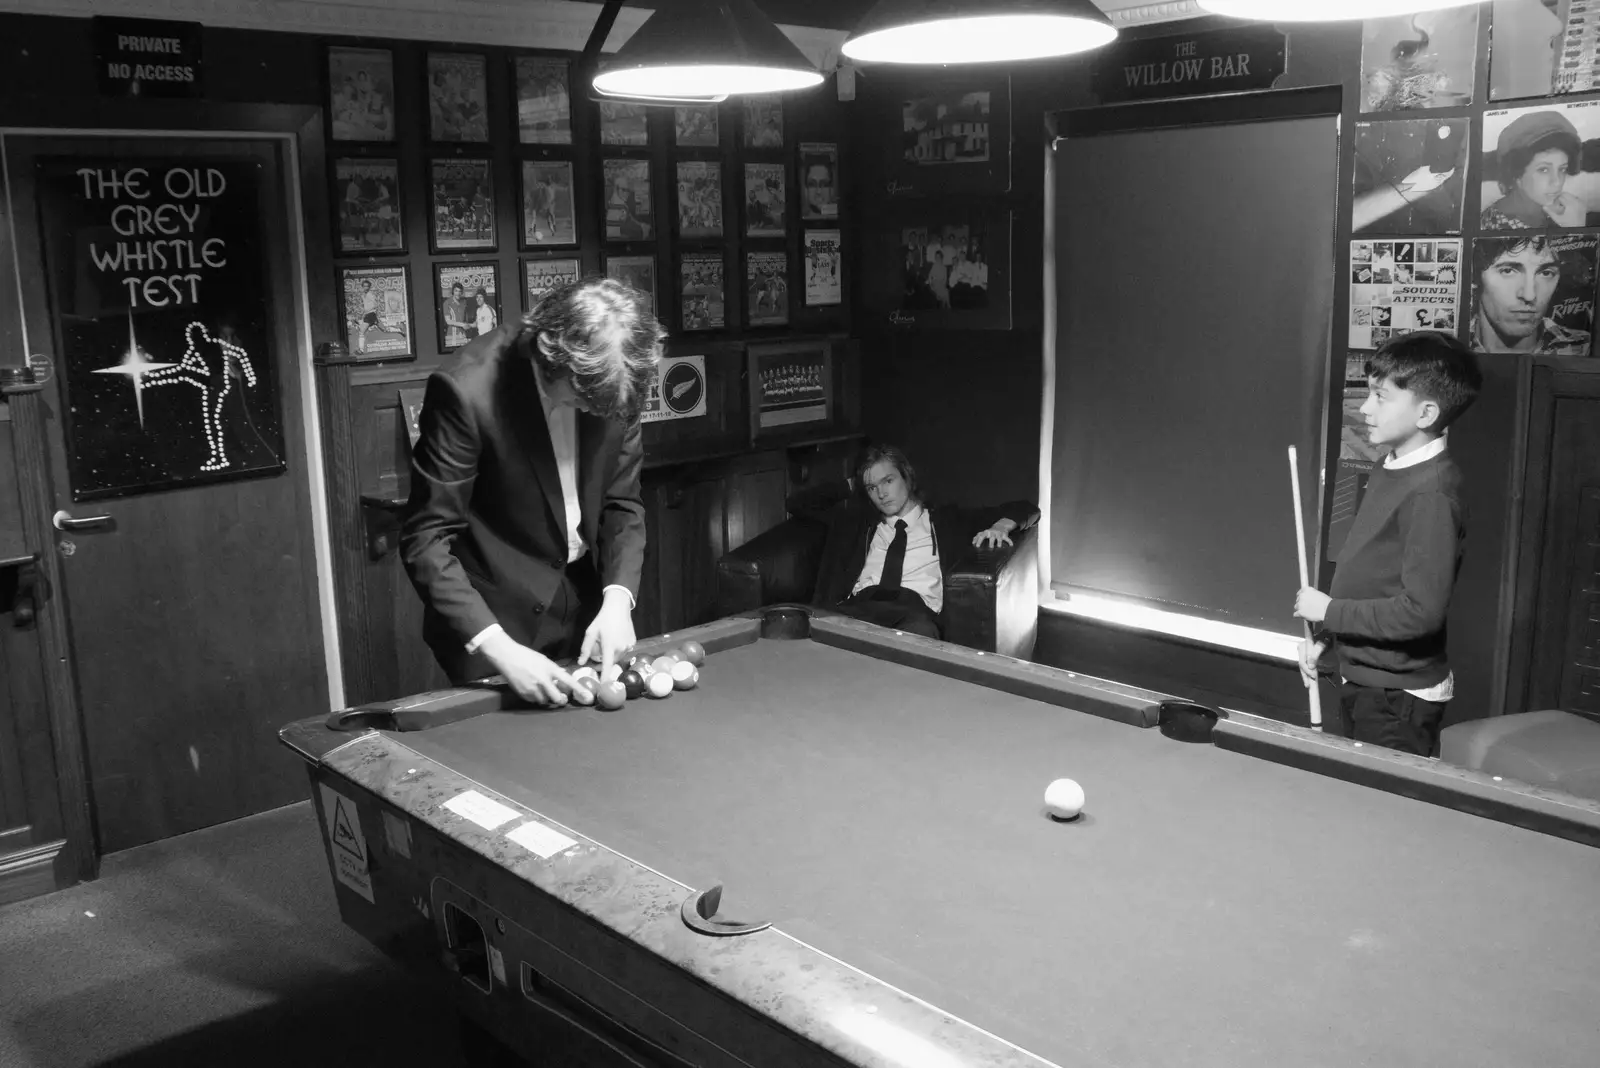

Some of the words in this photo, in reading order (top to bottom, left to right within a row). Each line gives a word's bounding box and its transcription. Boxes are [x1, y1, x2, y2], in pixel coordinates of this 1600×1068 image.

[118, 35, 181, 54] PRIVATE
[1174, 41, 1197, 57] THE
[108, 63, 130, 79] NO
[135, 64, 194, 82] ACCESS
[1123, 58, 1204, 87] WILLOW
[1210, 53, 1250, 79] BAR
[76, 169, 150, 199] THE
[164, 168, 226, 199] OLD
[111, 204, 200, 236] GREY
[90, 238, 227, 272] WHISTLE
[122, 274, 202, 307] TEST
[1551, 301, 1592, 321] RIVER
